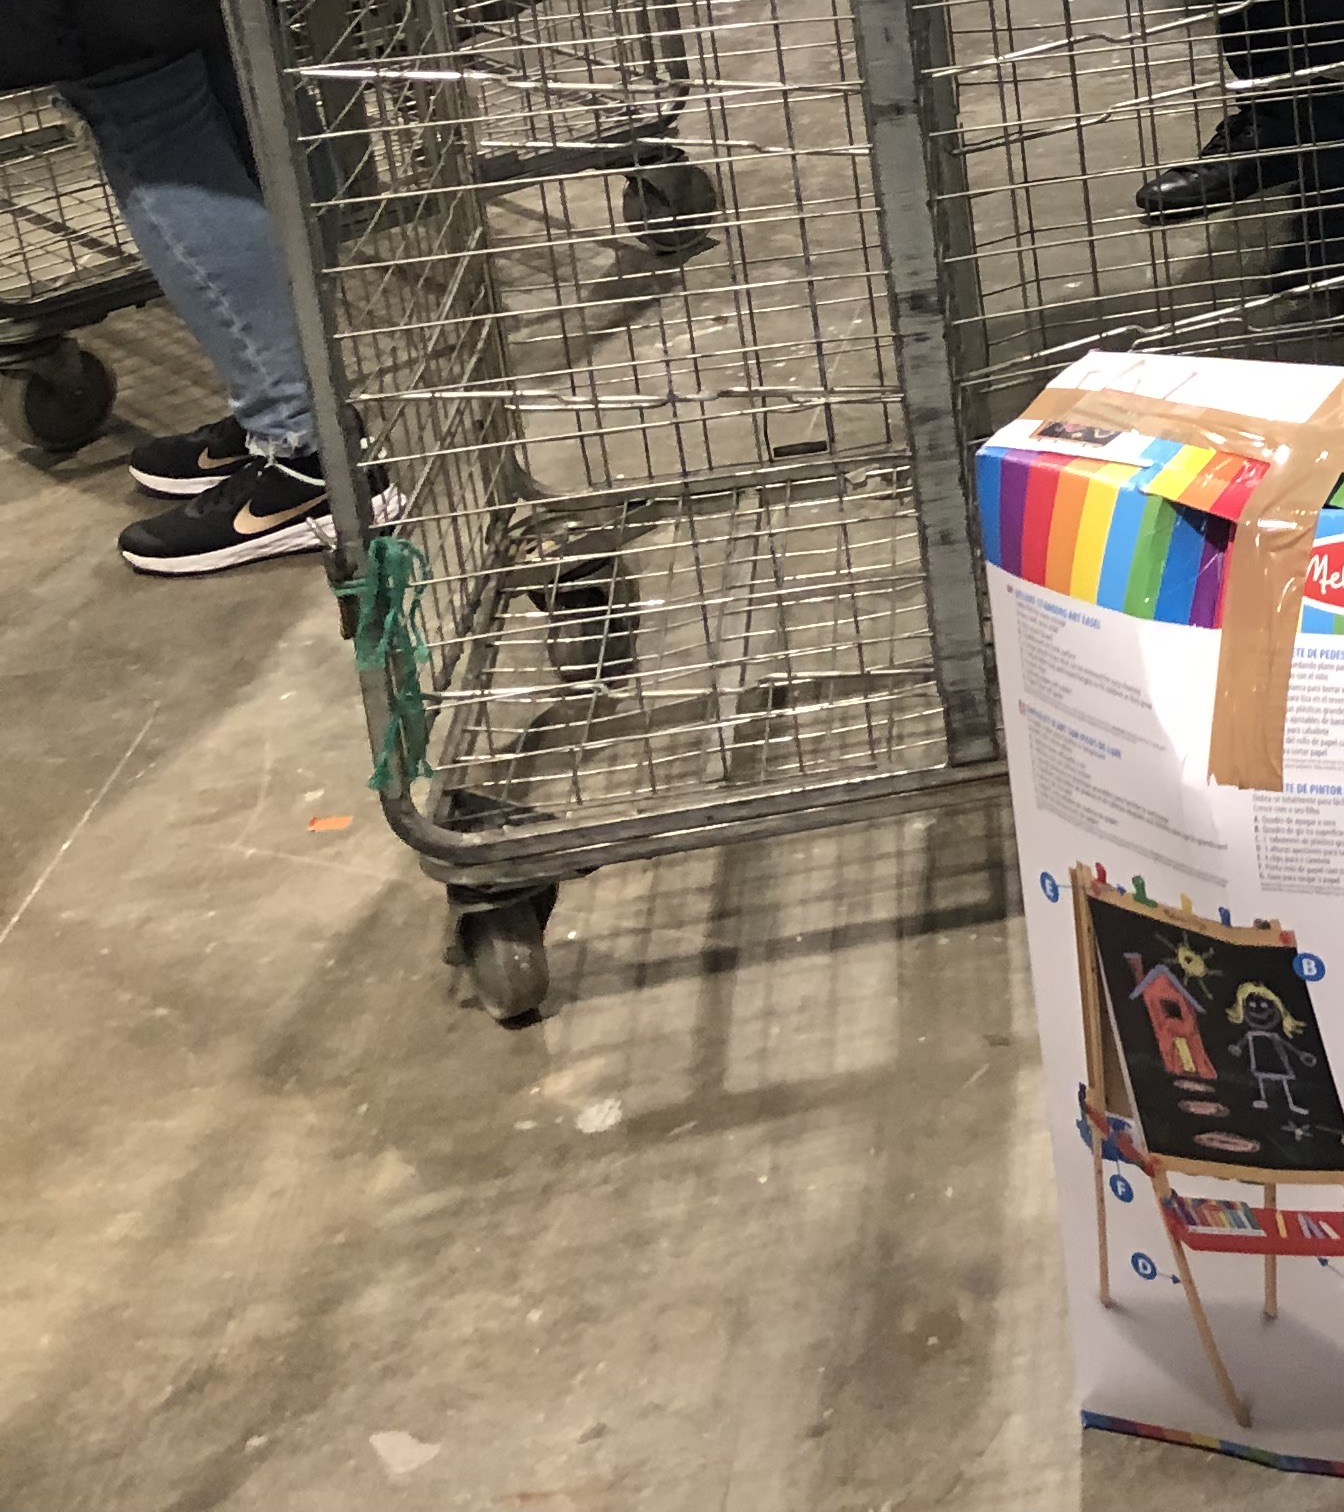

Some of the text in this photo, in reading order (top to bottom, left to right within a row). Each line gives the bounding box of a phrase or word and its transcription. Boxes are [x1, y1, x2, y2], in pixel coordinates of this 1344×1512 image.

[1307, 648, 1318, 659] DE
[1297, 784, 1307, 794] DE
[1309, 784, 1342, 796] PINTOR
